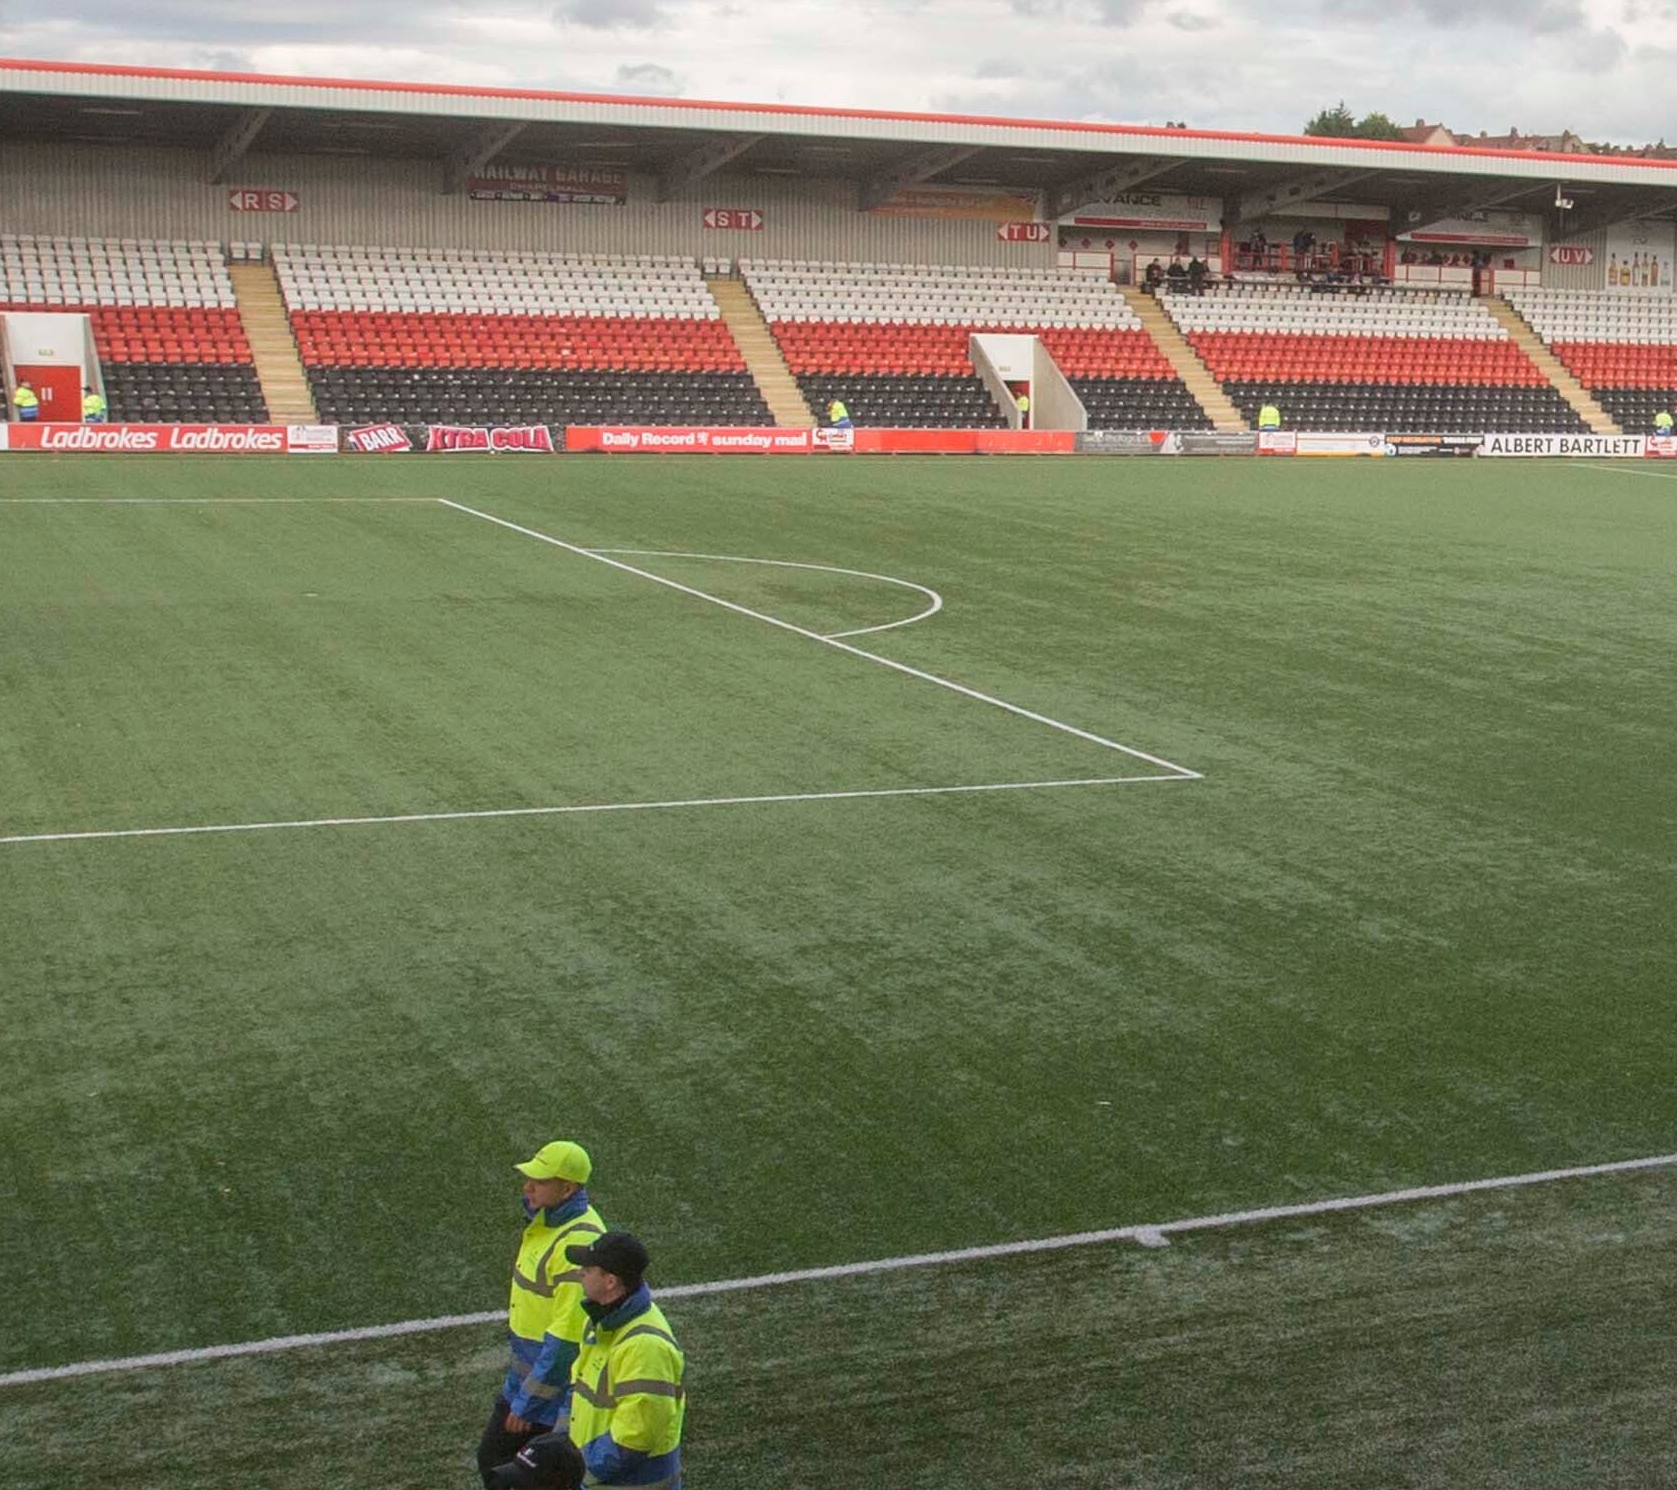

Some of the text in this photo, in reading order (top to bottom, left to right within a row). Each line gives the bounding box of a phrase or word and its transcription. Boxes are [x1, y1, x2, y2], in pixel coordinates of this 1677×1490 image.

[244, 192, 283, 209] R S
[718, 212, 749, 227] S T
[1012, 226, 1036, 240] T U
[1561, 249, 1584, 262] U V
[41, 426, 158, 448] Ladbrokes
[170, 427, 283, 450] Ladbrokes
[359, 427, 403, 450] BARR
[430, 426, 550, 449] XTRA COLA
[602, 432, 695, 447] Daily Record
[712, 433, 772, 448] sunday
[775, 433, 807, 446] mail
[1491, 437, 1554, 454] ALBERT
[1559, 438, 1641, 455] BARTLETT
